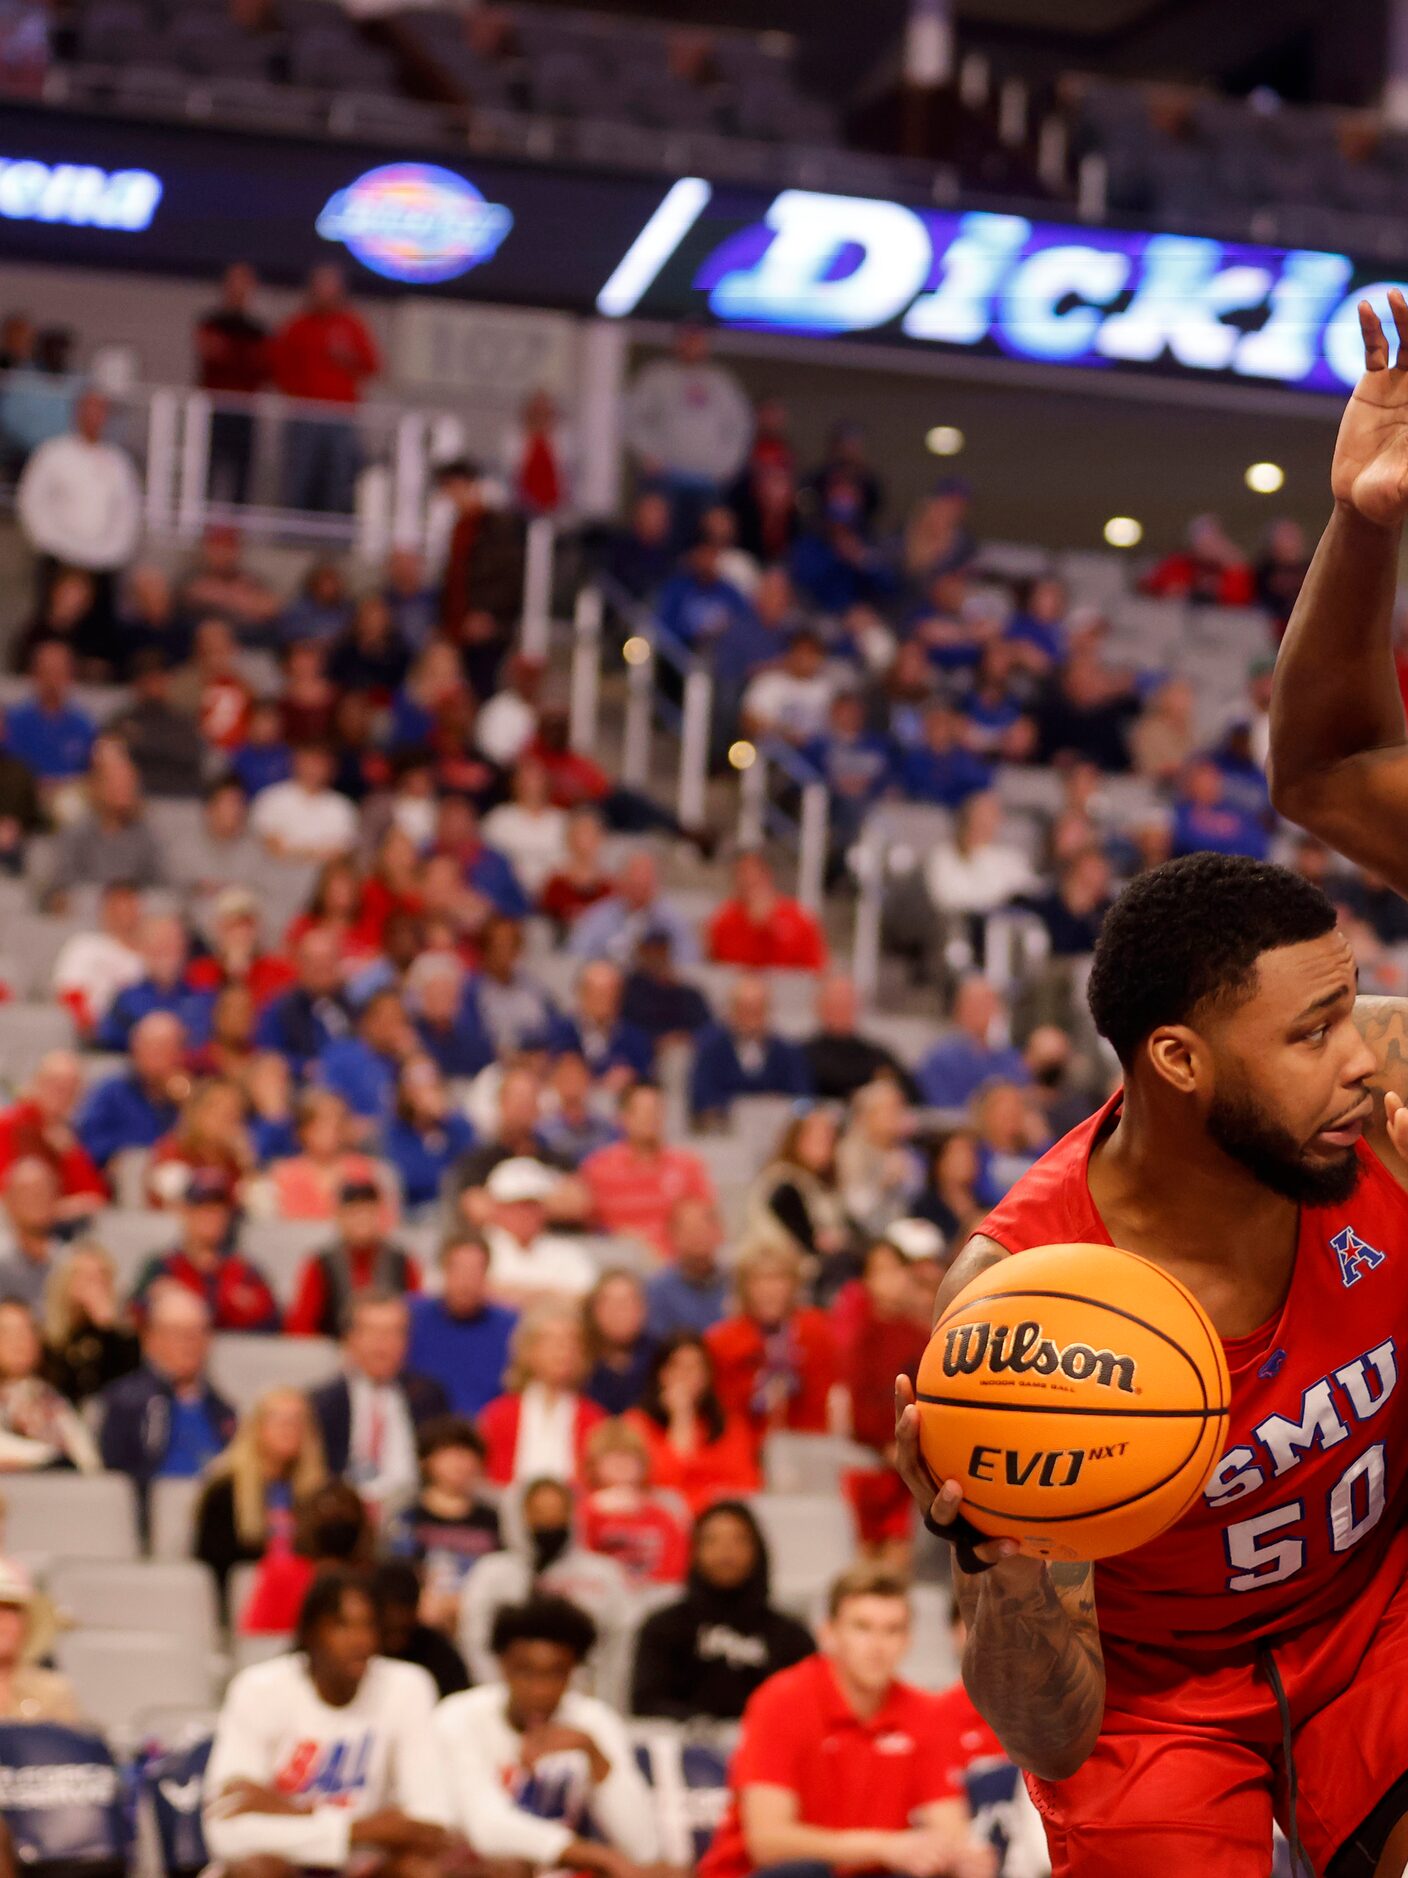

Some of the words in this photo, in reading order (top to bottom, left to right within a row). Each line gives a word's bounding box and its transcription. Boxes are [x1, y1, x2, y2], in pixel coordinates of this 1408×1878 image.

[0, 157, 163, 232] ena
[942, 1320, 1136, 1394] Wilson
[1203, 1336, 1399, 1508] SMU
[968, 1444, 1085, 1487] EVO
[1088, 1441, 1129, 1461] NXT
[1224, 1442, 1387, 1593] 50
